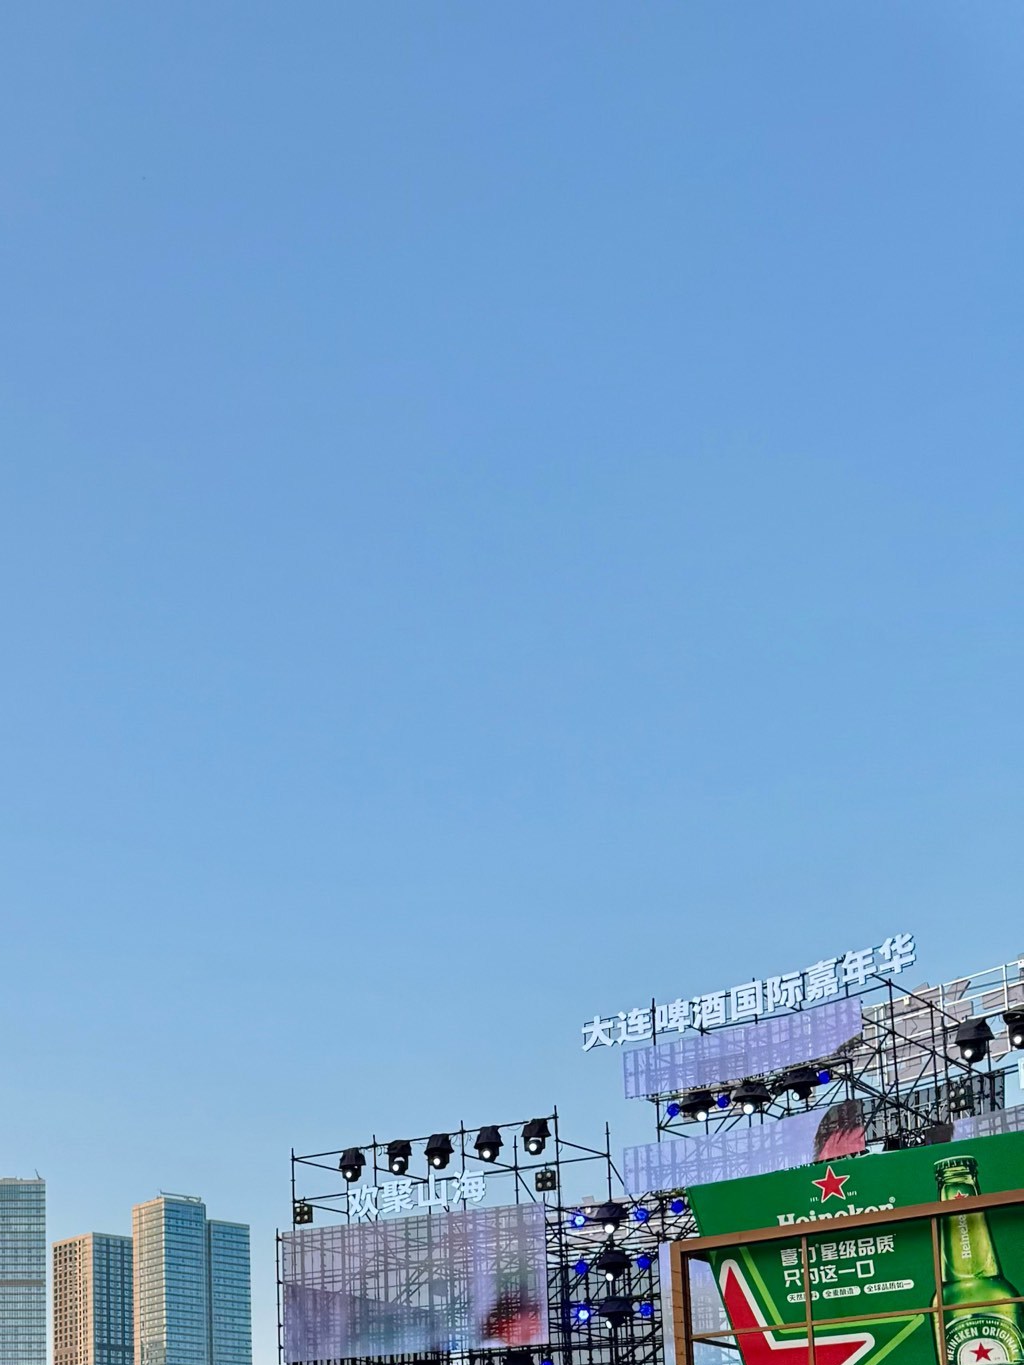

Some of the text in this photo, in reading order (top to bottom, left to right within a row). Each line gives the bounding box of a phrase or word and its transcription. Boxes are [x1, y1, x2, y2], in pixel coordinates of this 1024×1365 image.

[581, 932, 918, 1052] 大连啤酒国际嘉年华
[347, 1169, 486, 1218] 欢聚山海
